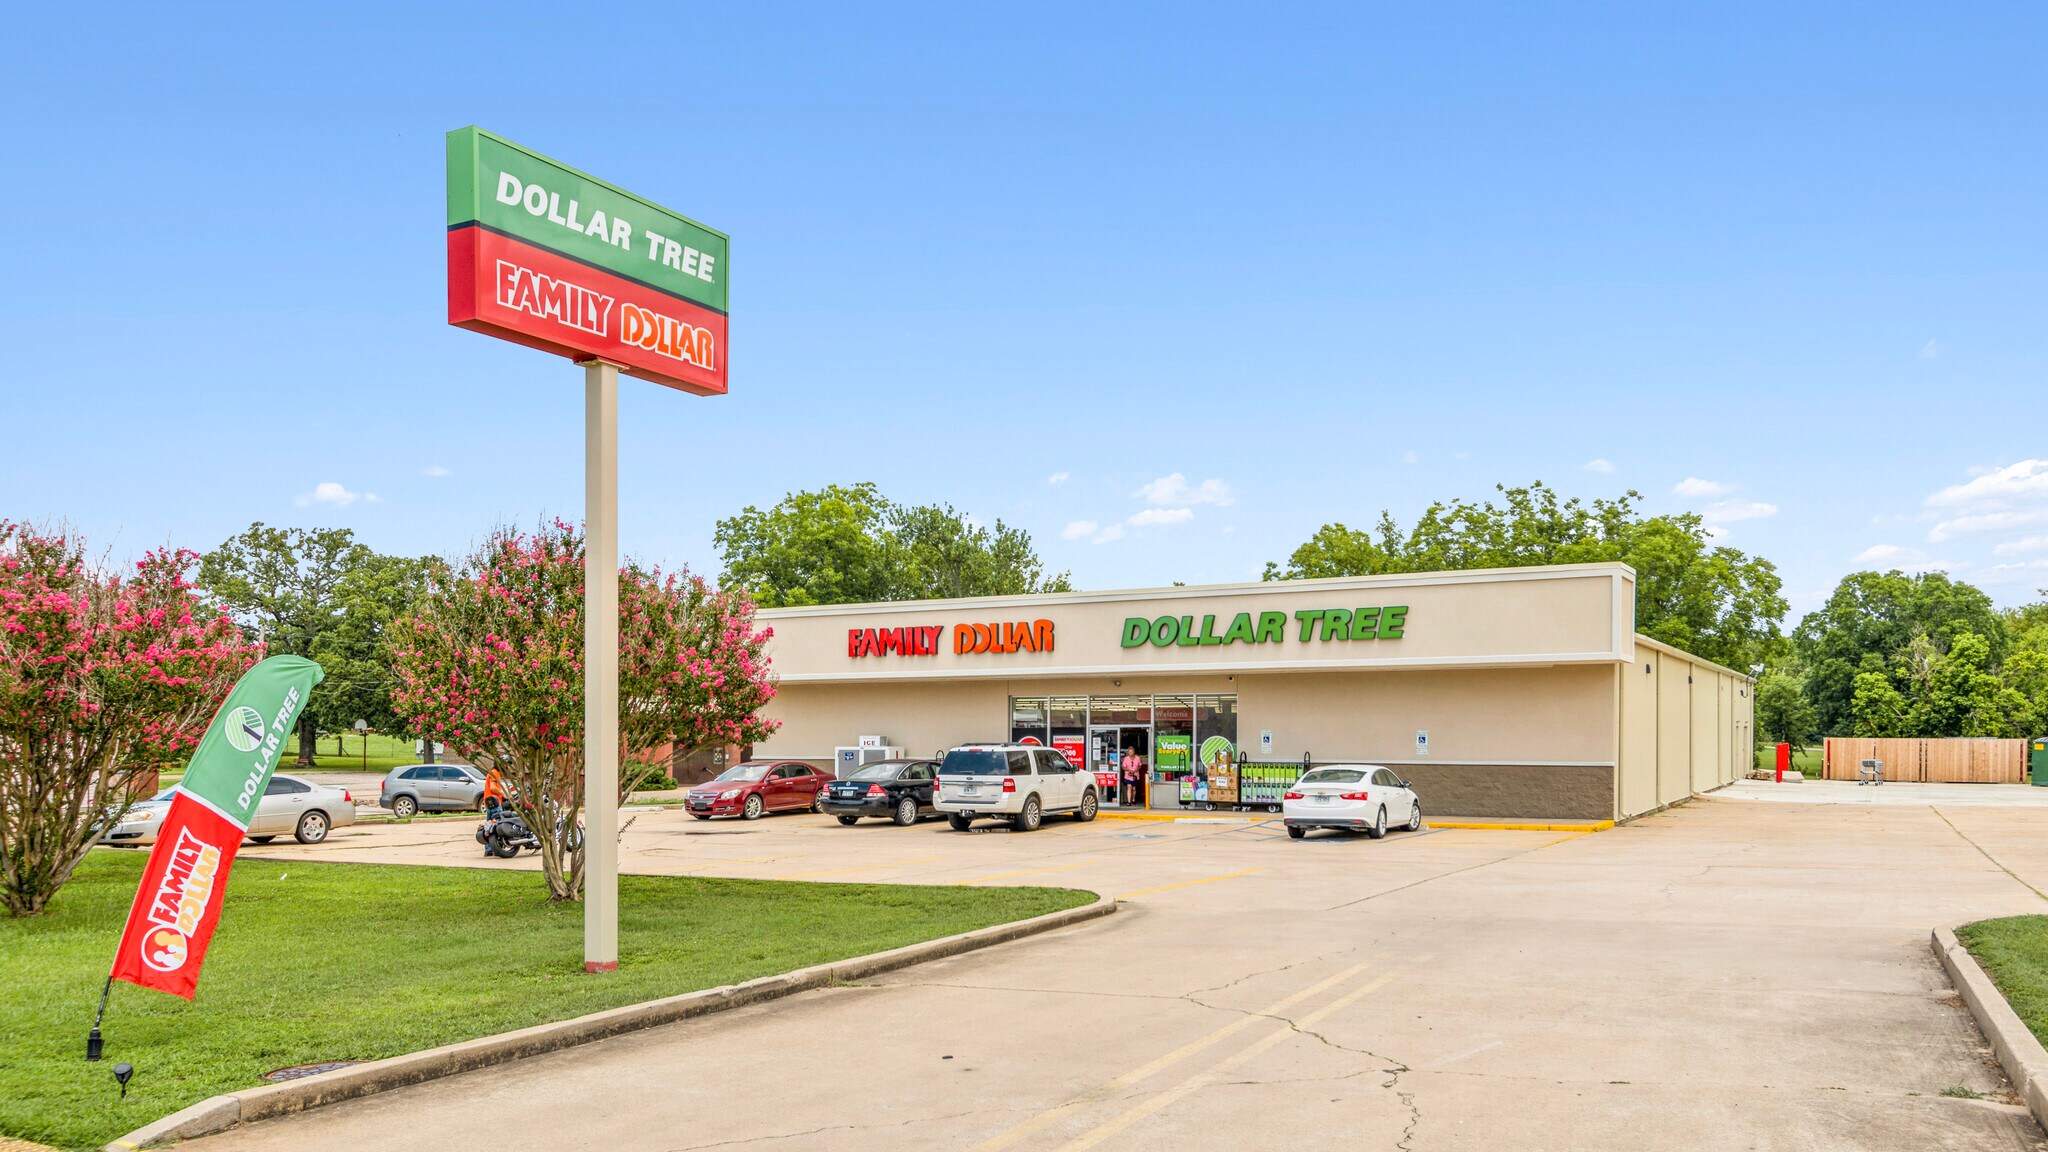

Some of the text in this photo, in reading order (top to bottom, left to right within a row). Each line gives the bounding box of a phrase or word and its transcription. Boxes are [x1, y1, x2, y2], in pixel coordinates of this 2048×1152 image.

[496, 171, 715, 283] DOLLAR TREE
[496, 259, 714, 371] FAMILY DOLLAR
[848, 619, 1055, 658] FAMILY DOLLAR
[1120, 605, 1409, 648] DOLLAR TREE
[236, 686, 301, 810] DOLLAR TREE
[1155, 710, 1189, 718] Welcome
[1160, 741, 1187, 750] Value
[148, 825, 204, 926] FAMILY
[175, 845, 220, 936] DOLLAR
